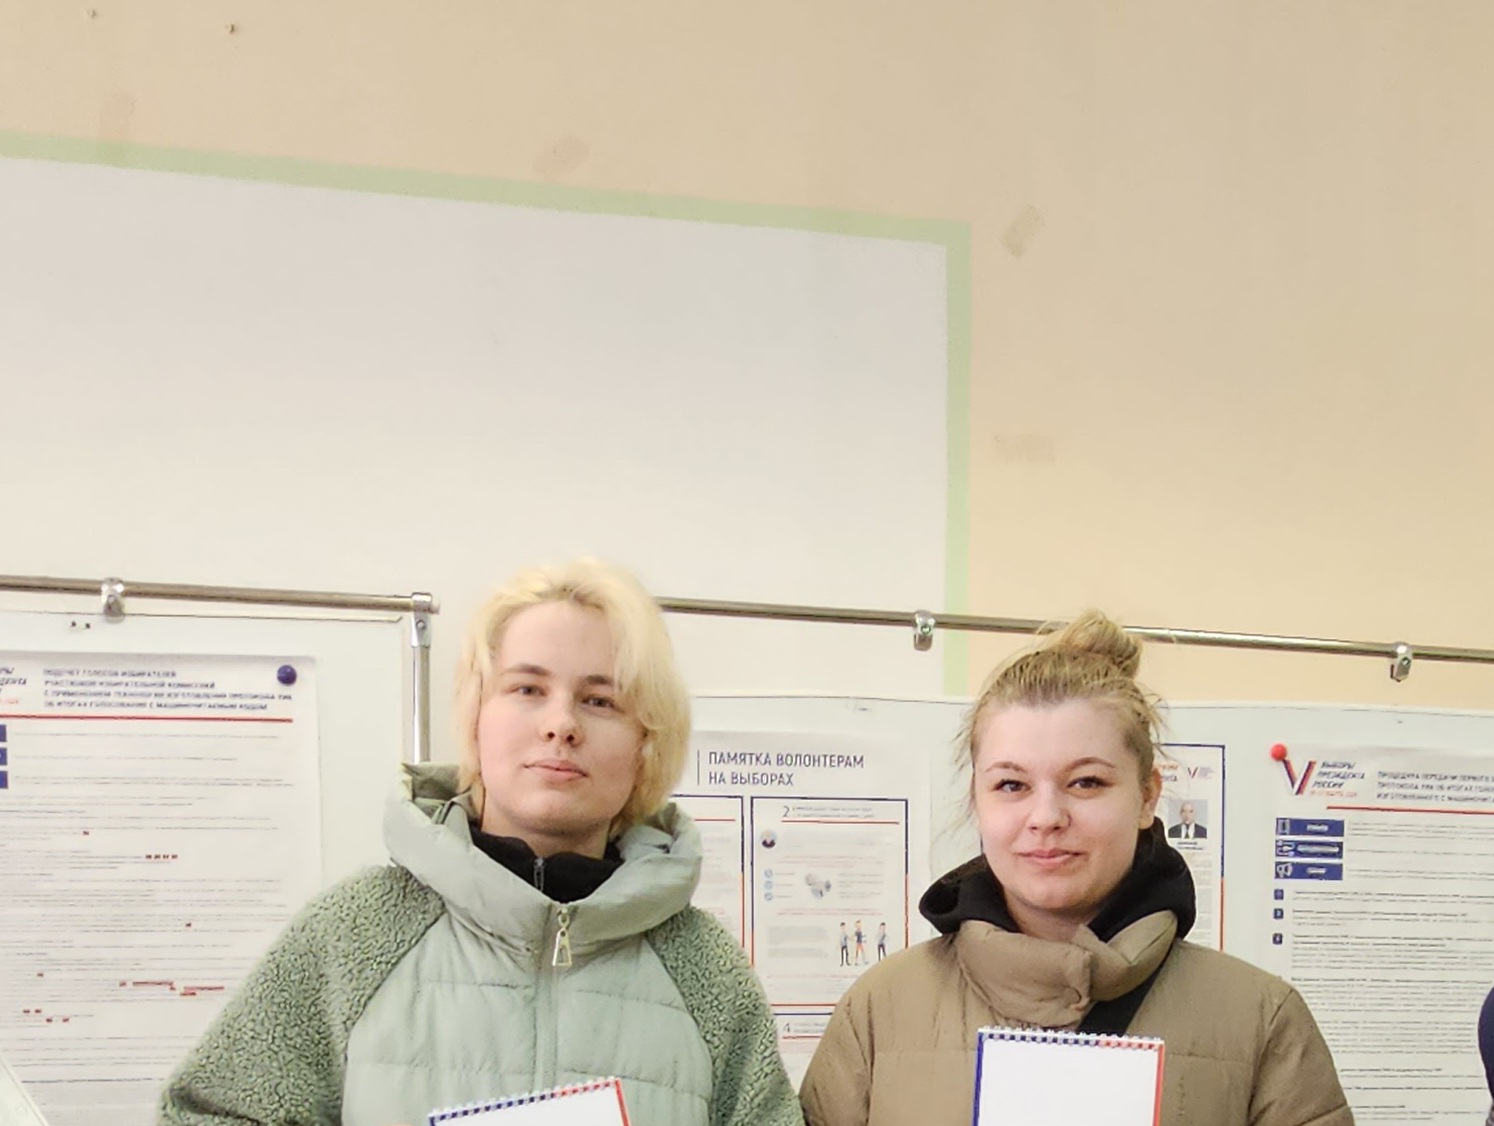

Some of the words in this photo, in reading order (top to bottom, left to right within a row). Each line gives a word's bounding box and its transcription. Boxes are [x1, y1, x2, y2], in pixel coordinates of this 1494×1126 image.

[708, 751, 772, 767] ПАМЯТКА
[776, 753, 865, 768] ВОЛОНТЕРАМ
[708, 772, 727, 785] НА
[730, 772, 794, 786] ВЫБОРАХ
